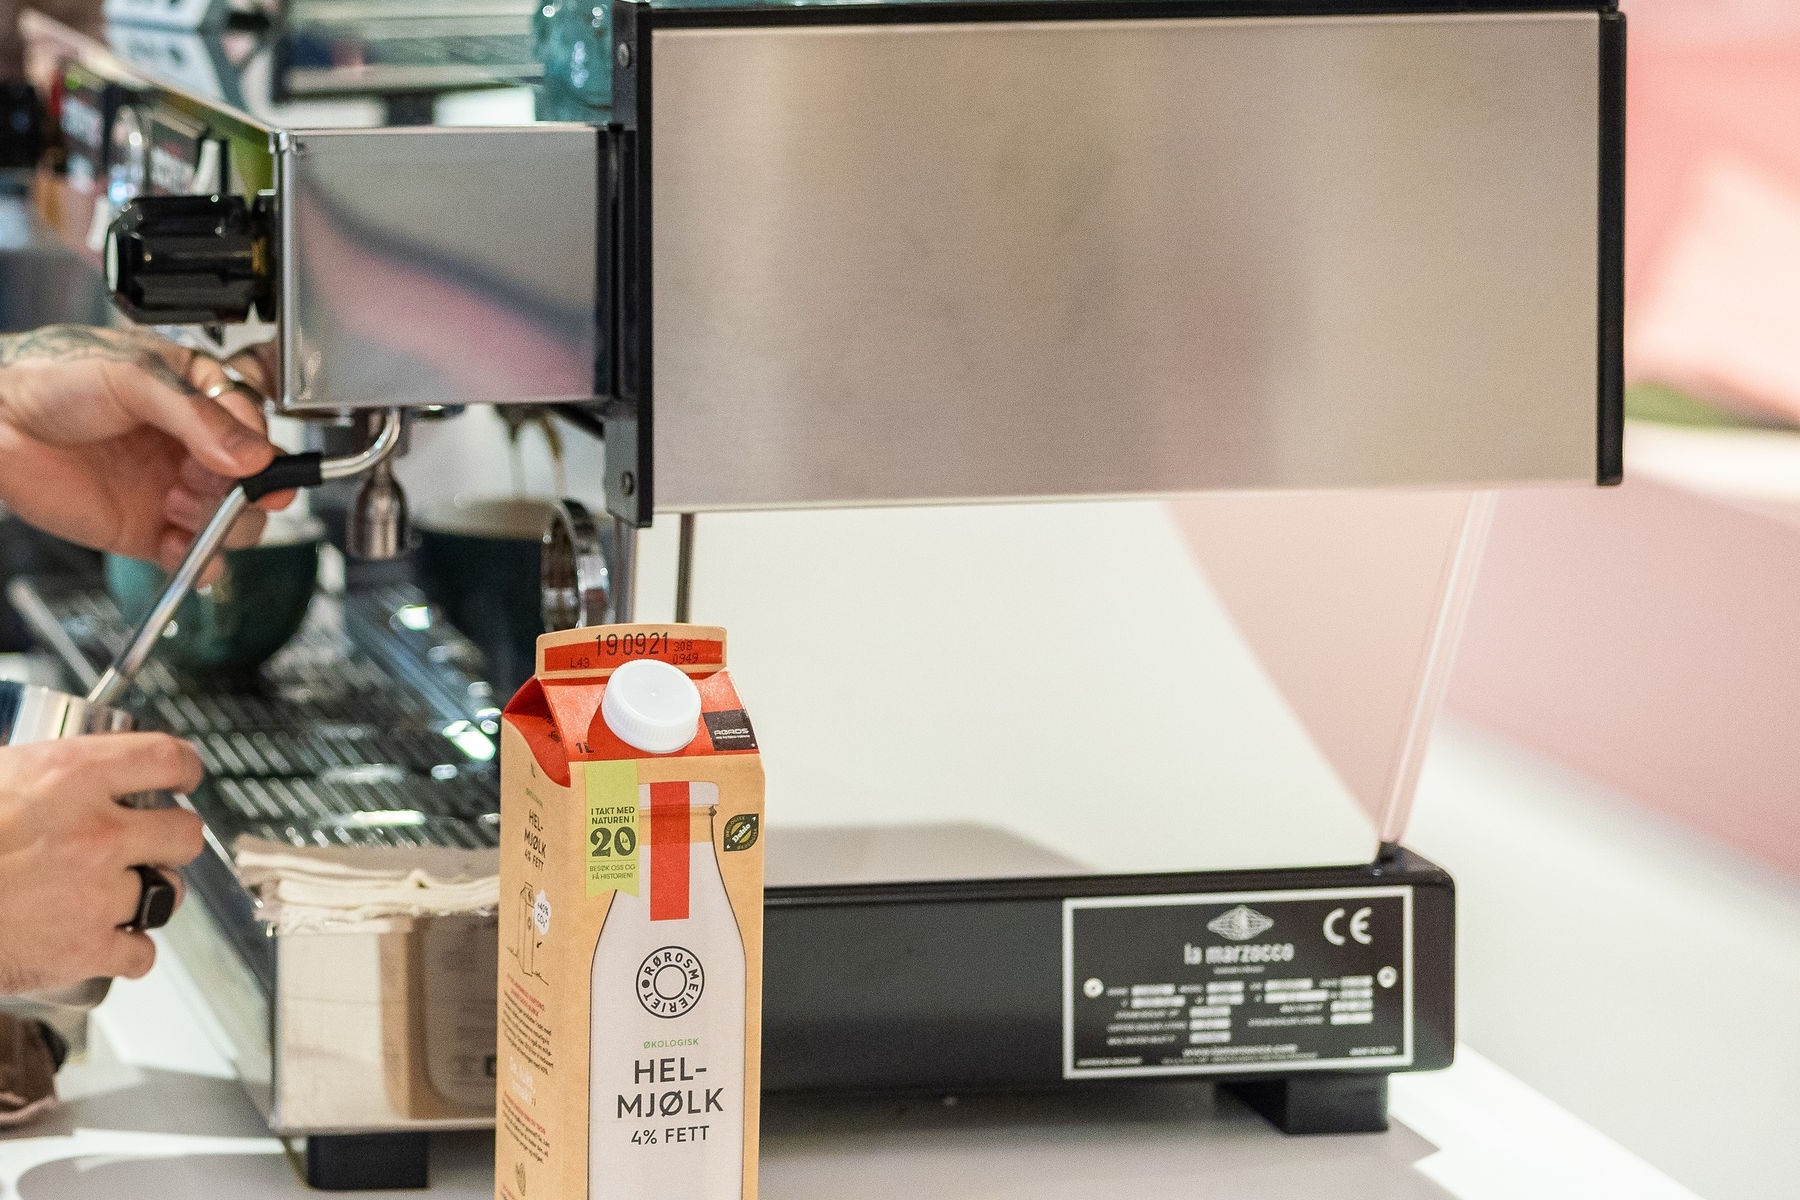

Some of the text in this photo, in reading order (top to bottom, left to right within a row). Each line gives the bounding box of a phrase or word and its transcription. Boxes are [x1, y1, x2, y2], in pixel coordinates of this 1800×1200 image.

[591, 816, 630, 825] NATUREN
[595, 807, 614, 815] TAKT
[616, 806, 635, 815] MED
[590, 826, 637, 858] 20
[731, 823, 751, 843] Debio
[624, 863, 636, 871] OG
[643, 951, 700, 1013] RØROSMEIERIET
[643, 1037, 699, 1049] ØKOLOGISK
[633, 1057, 707, 1084] HEL-
[617, 1088, 724, 1119] MJØLK
[630, 1125, 710, 1145] 4% FETT
